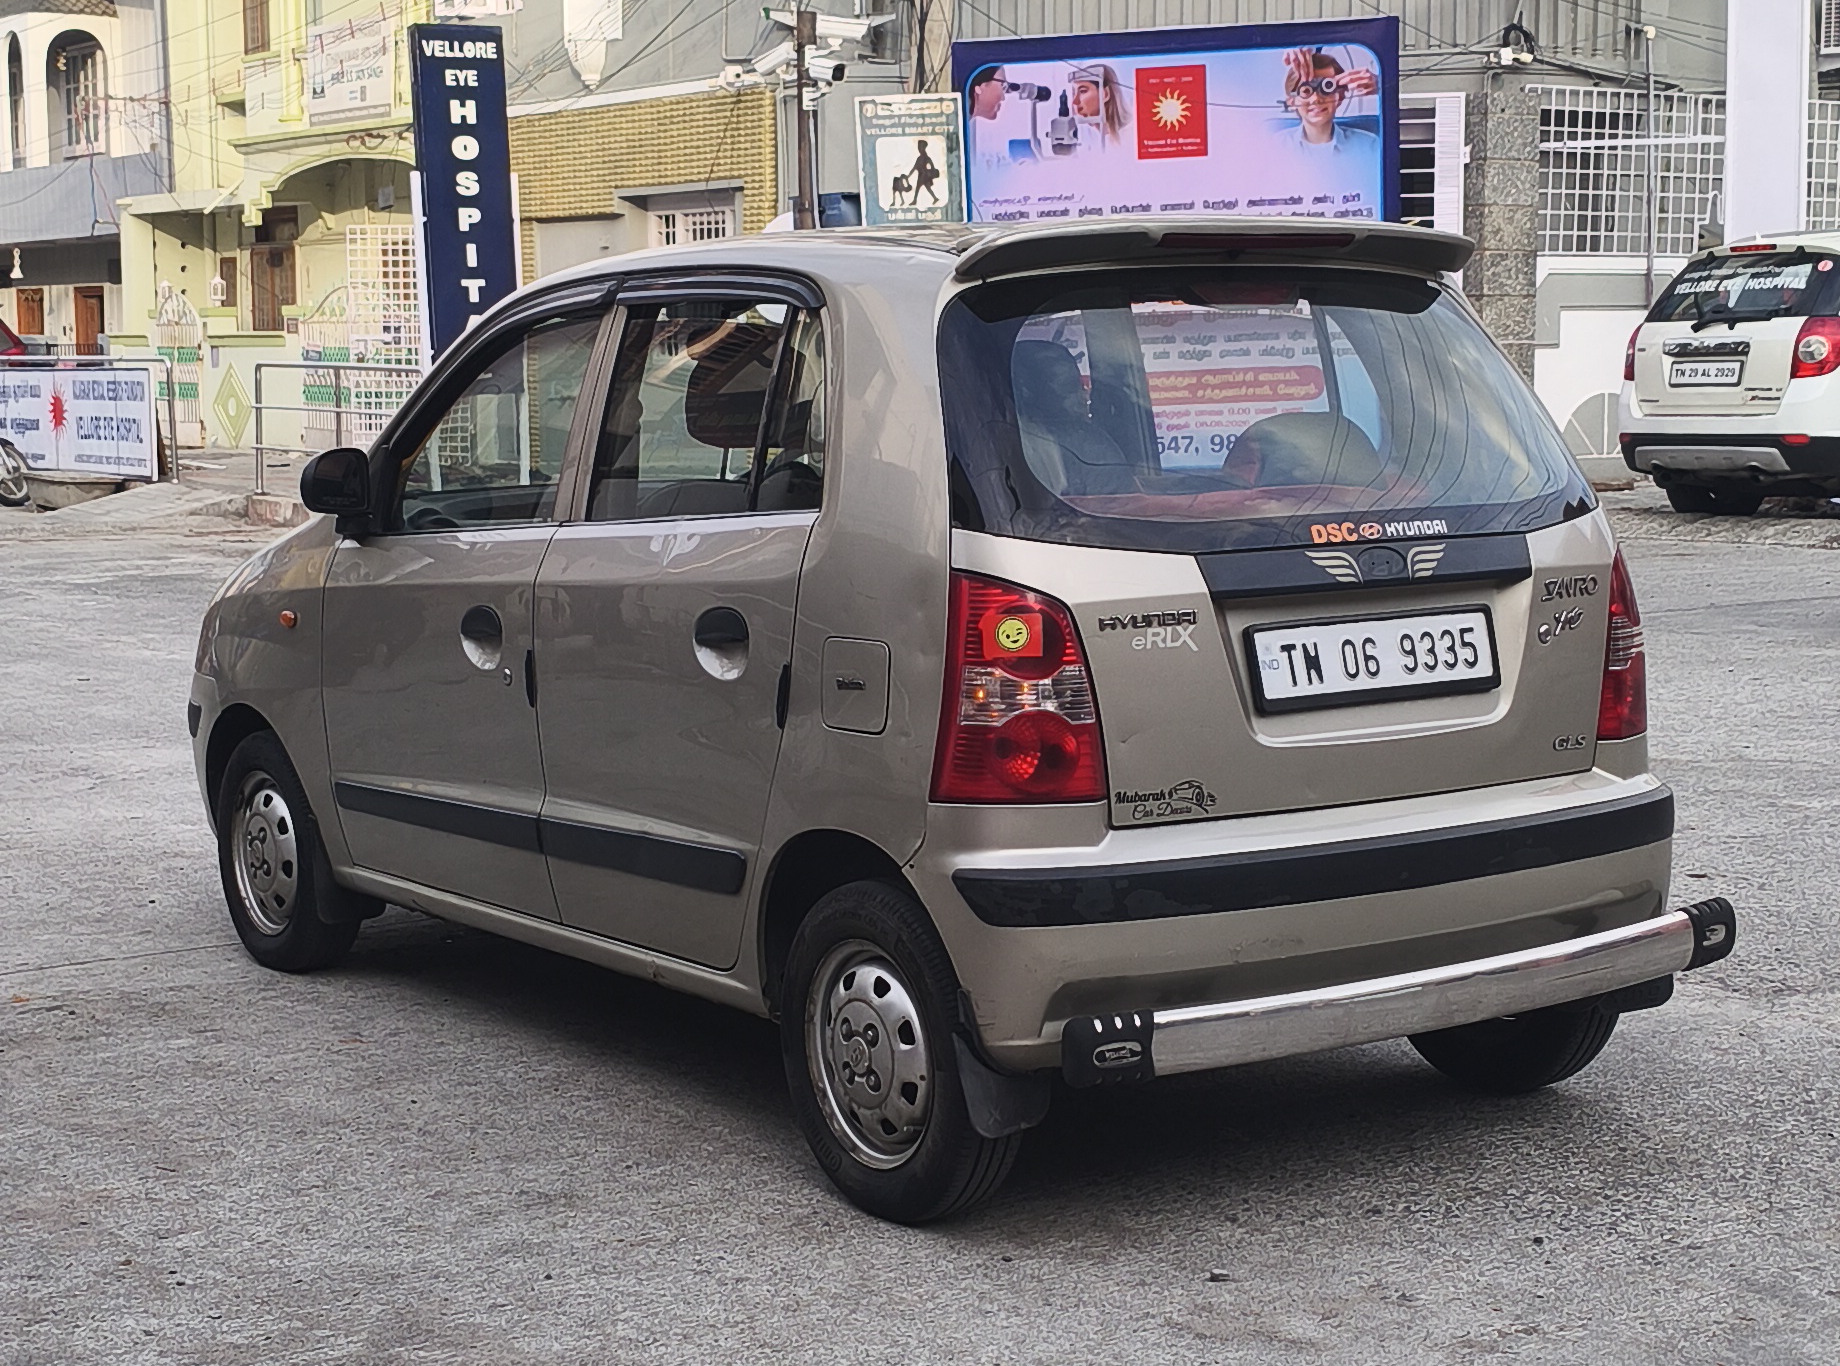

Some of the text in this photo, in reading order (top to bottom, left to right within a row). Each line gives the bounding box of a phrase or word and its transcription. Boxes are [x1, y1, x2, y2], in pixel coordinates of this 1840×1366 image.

[421, 39, 498, 59] VELLORE
[444, 69, 479, 87] EYE
[865, 125, 955, 135] VELLORE SMART CITY
[1674, 280, 1717, 295] VELLORE
[1745, 275, 1807, 290] HOSPITAL
[1675, 367, 1736, 378] TN 29 AL 2929
[1311, 519, 1448, 544] DSC HYUNDAI
[1541, 574, 1598, 602] SANTRO
[1098, 608, 1198, 631] HYUNDAI
[1131, 625, 1199, 651] eRLX
[1261, 658, 1280, 670] IND
[1280, 626, 1479, 687] TN 06 9335
[1553, 734, 1587, 751] GLS
[1115, 789, 1166, 805] Mubarak
